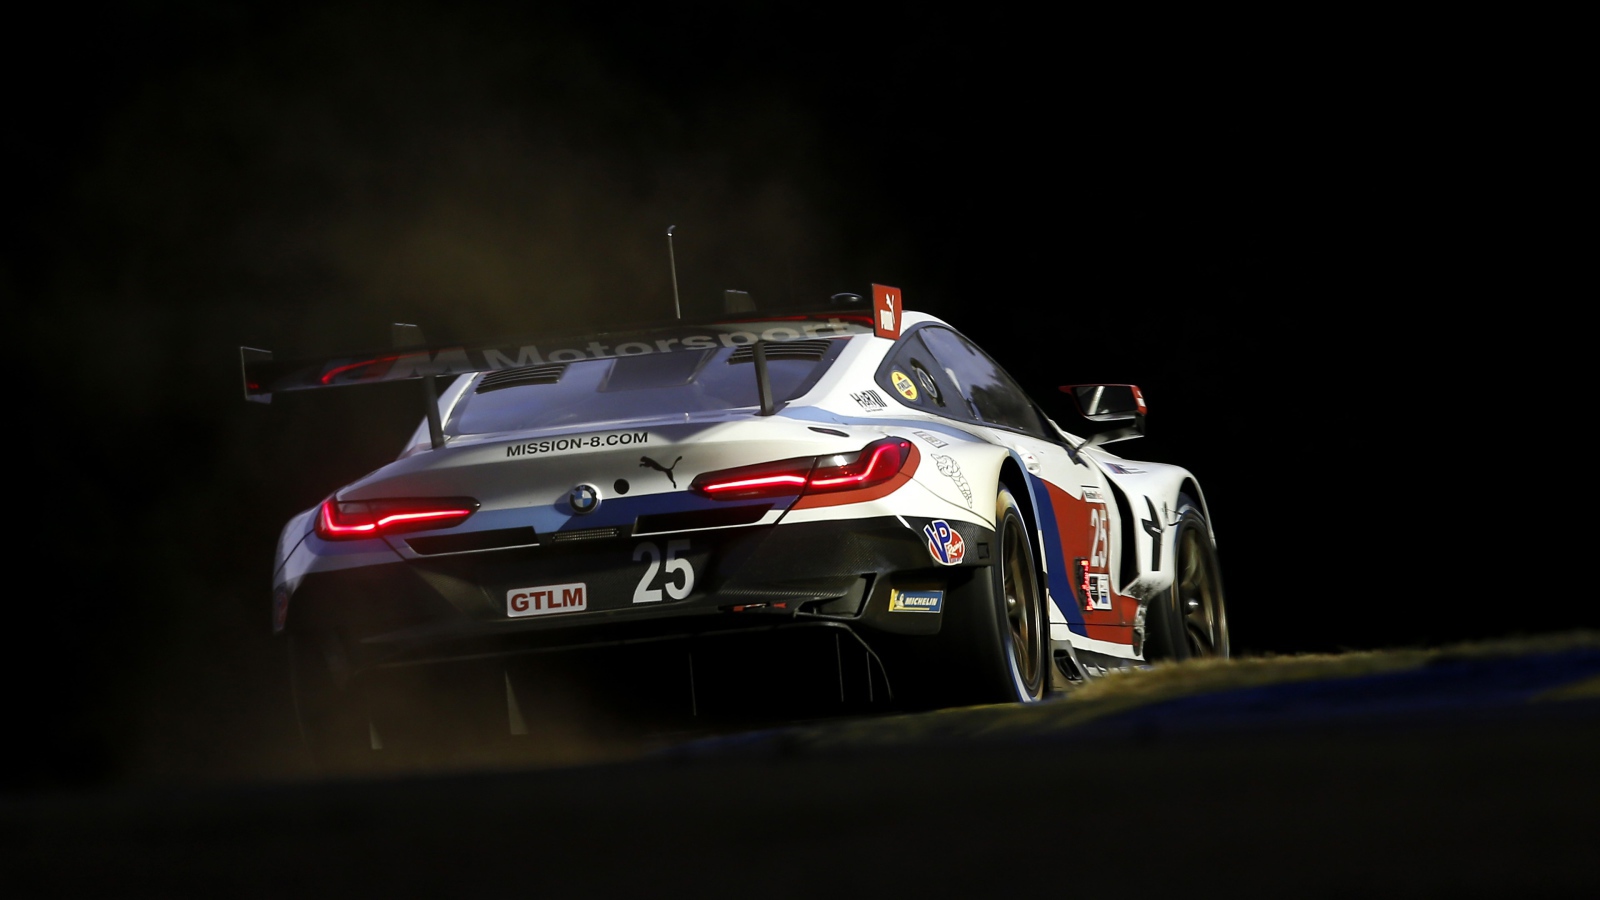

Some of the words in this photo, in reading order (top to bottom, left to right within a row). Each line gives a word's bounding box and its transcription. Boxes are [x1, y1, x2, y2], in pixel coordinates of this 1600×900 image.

[482, 317, 850, 370] Motorsport
[506, 431, 648, 457] MISSION-8.COM
[925, 521, 951, 564] VP
[1090, 508, 1108, 568] 25
[632, 538, 695, 604] 25
[510, 587, 584, 612] GTLM
[904, 597, 938, 606] MICHELIN
